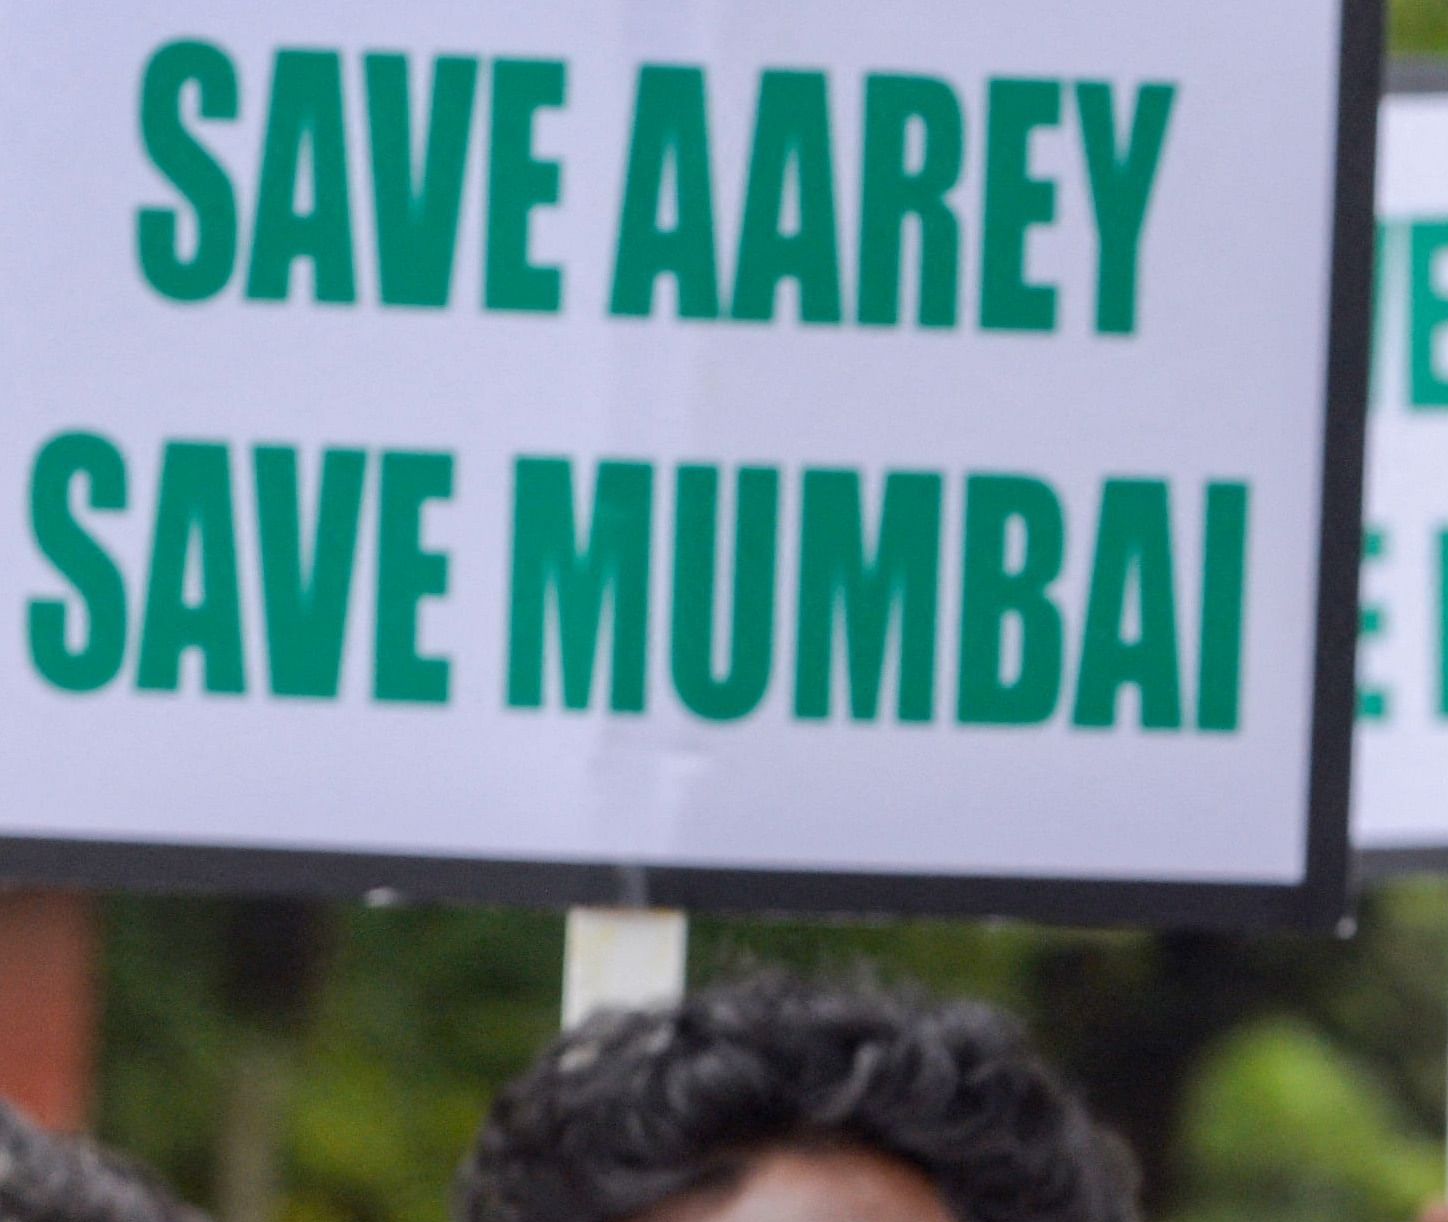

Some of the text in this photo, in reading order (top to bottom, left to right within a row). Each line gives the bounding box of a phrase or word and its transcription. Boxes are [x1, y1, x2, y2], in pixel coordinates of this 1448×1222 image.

[136, 38, 568, 314] SAVE
[607, 62, 1177, 337] AAREY
[26, 430, 457, 706] SAVE
[505, 455, 1251, 735] MUMBAI
